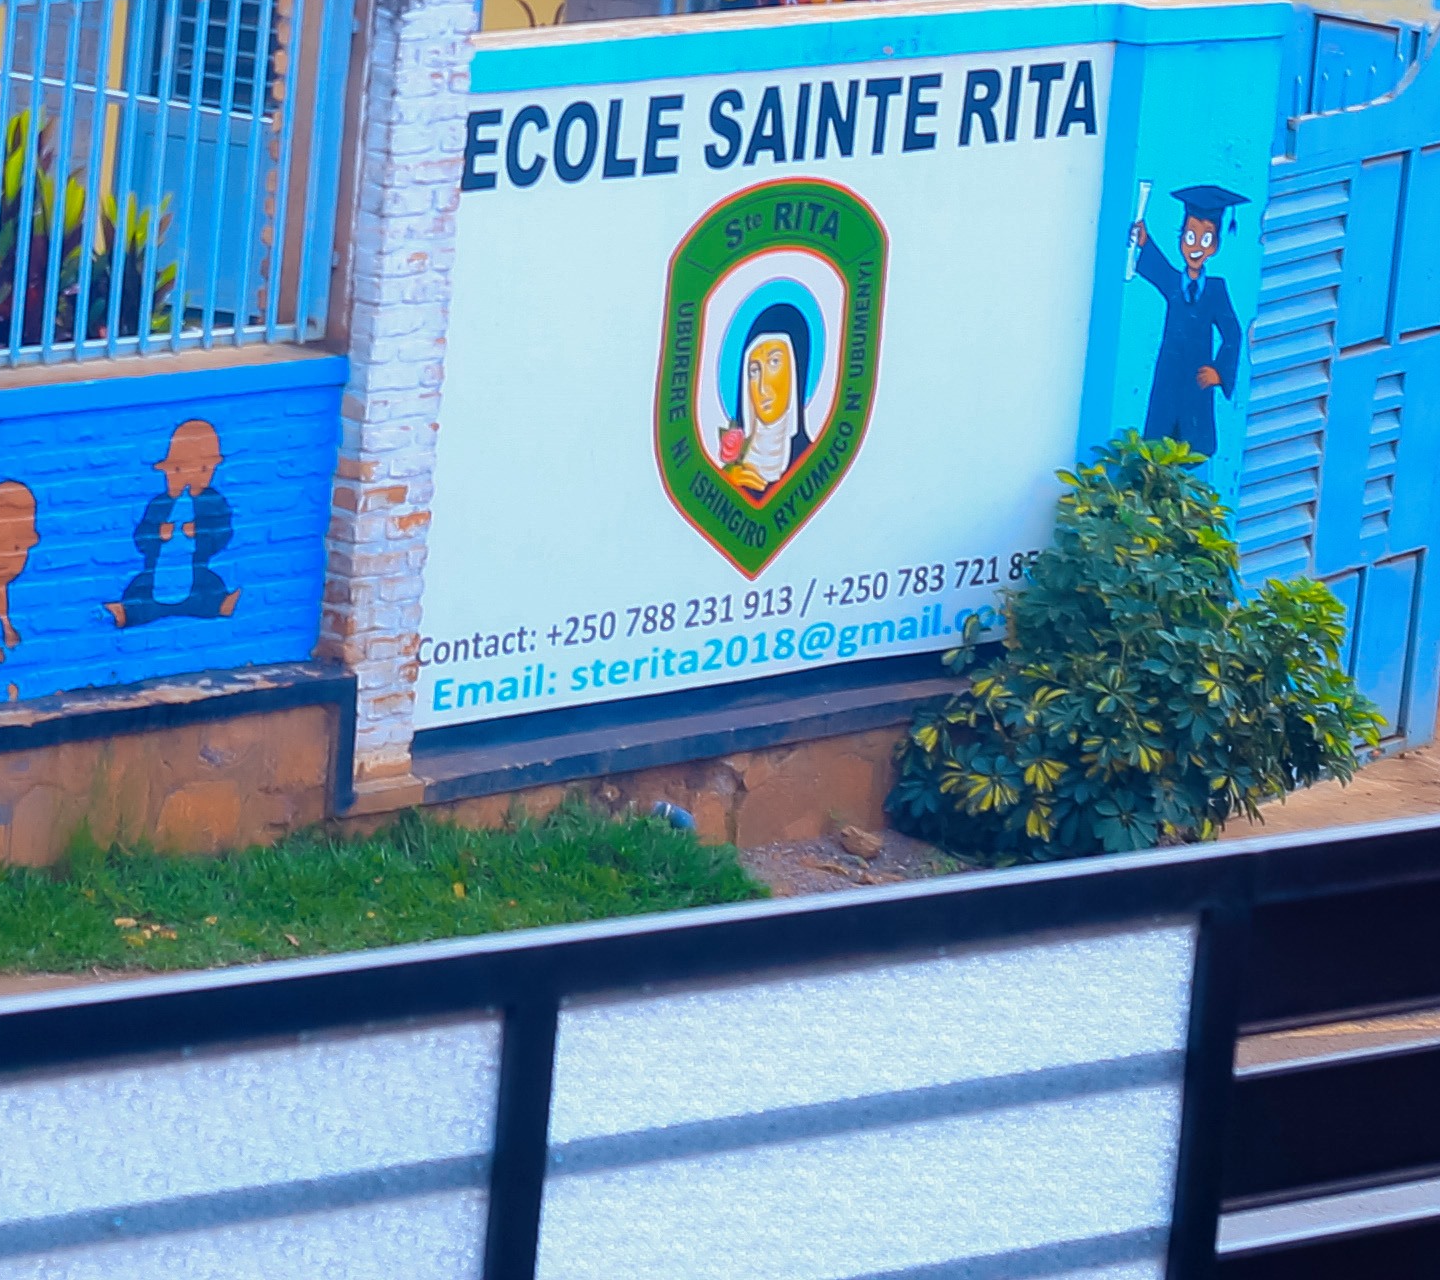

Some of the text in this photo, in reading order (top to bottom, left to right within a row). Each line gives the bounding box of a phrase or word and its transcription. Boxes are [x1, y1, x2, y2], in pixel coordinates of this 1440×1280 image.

[460, 59, 1099, 193] ECOLE SAINTE RITA
[772, 201, 841, 241] RITA
[668, 301, 696, 425] UBURERE
[852, 258, 875, 380] UBUMENYI
[670, 435, 691, 470] NI
[773, 420, 855, 534] RY'UMUCO
[688, 469, 768, 550] ISHINGIRO
[416, 626, 536, 667] Contact:
[547, 611, 617, 647] +250
[626, 602, 676, 637] 788
[684, 594, 735, 628] 231
[743, 585, 793, 620] 913
[799, 578, 817, 619] /
[823, 571, 888, 607] +250
[897, 563, 945, 597] 783
[955, 556, 1000, 589] 721
[433, 663, 556, 712] Email:
